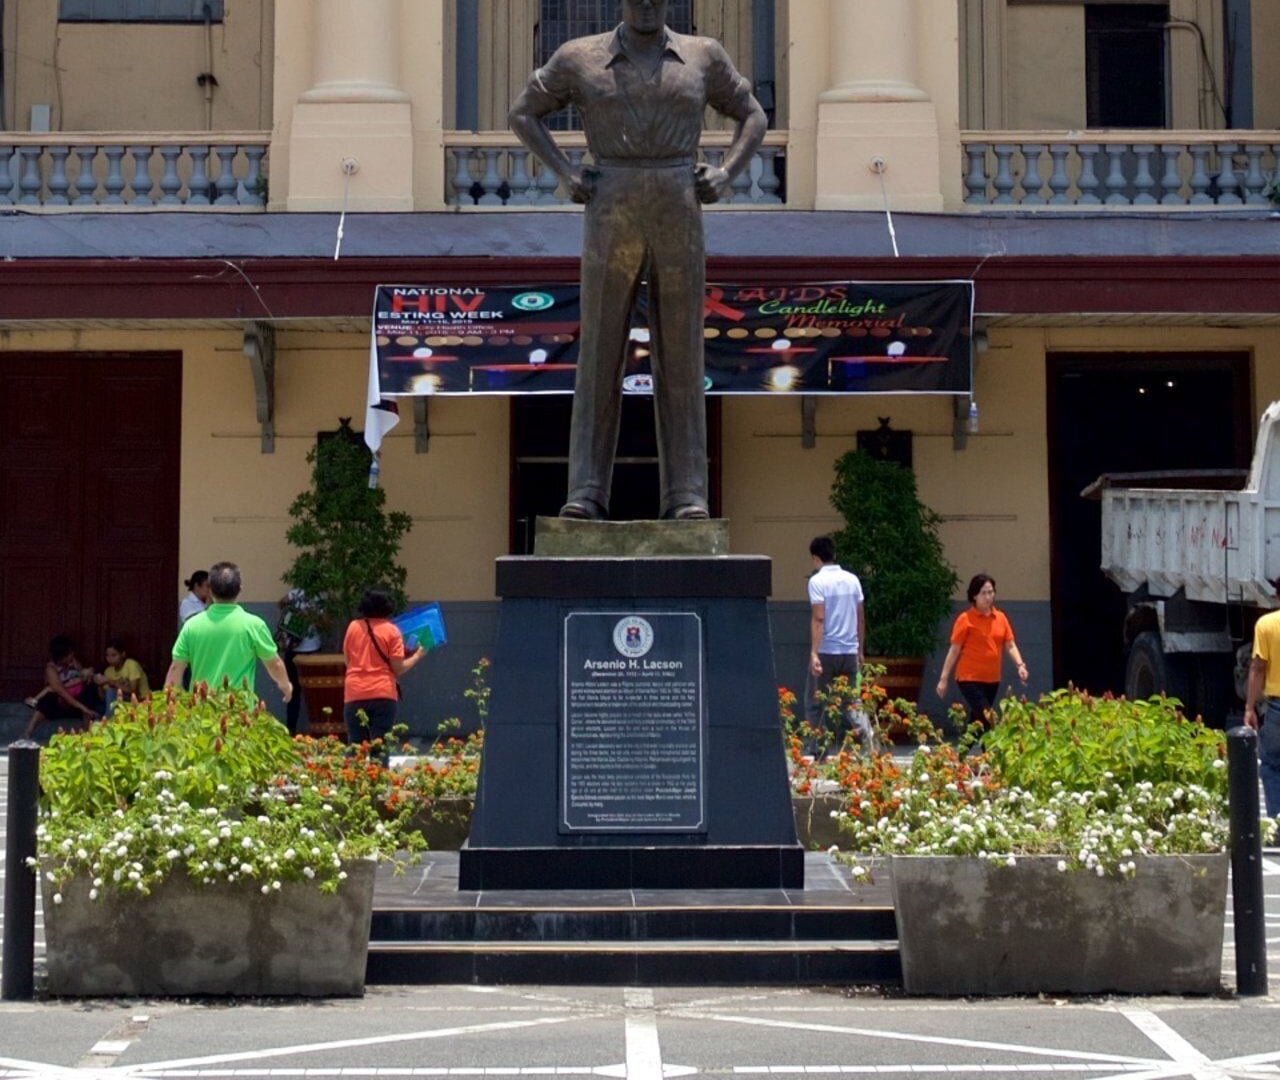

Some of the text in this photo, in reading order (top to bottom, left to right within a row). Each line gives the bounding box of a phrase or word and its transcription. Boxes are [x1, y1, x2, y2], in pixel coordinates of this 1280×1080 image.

[392, 294, 486, 312] HIV
[758, 299, 887, 317] Candlelight
[378, 311, 504, 319] ESTING WEEK
[784, 313, 906, 329] Memorial
[584, 660, 683, 669] Arsenio H. Lacson
